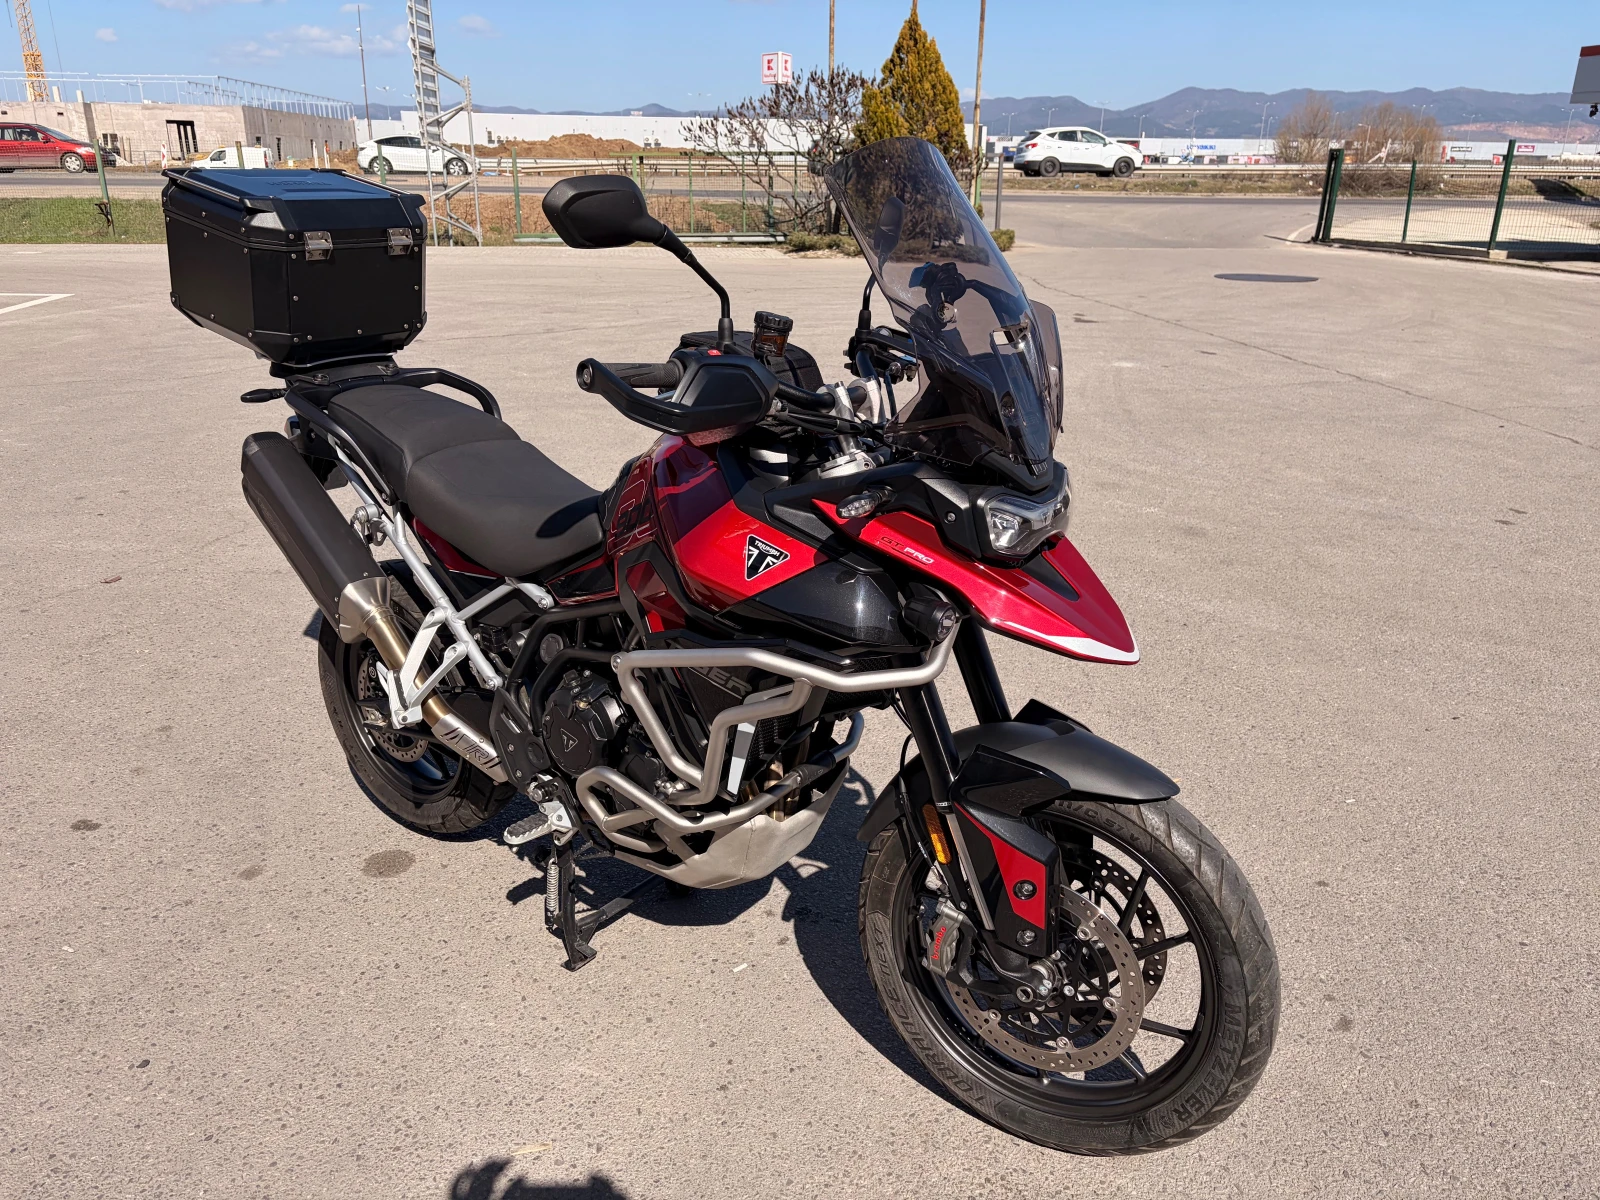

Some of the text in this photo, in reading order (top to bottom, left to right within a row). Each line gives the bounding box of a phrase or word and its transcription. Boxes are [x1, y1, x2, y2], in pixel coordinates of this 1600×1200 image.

[767, 59, 774, 70] K
[754, 540, 780, 557] TRIUMPH
[881, 536, 935, 564] GT PRO
[931, 926, 947, 960] brembo
[1172, 1002, 1243, 1124] METZELER
